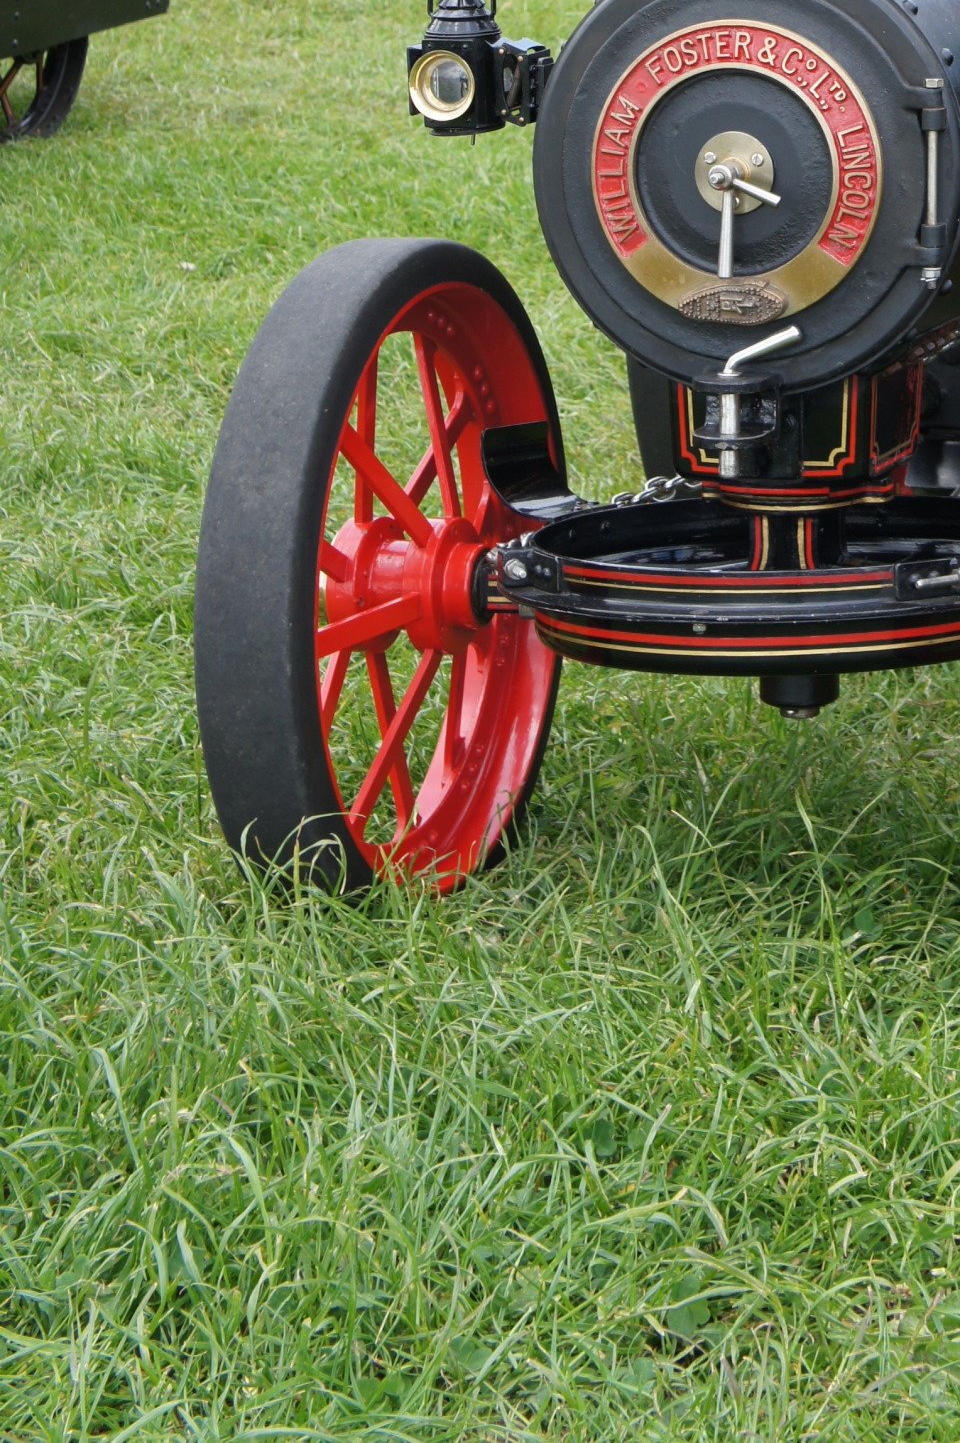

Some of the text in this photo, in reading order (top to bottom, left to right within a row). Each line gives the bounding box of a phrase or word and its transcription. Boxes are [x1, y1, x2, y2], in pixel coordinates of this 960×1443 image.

[598, 96, 641, 245] WILLIAM
[645, 30, 751, 85] FOSTER
[757, 36, 779, 67] &
[828, 122, 873, 250] LINCOLN
